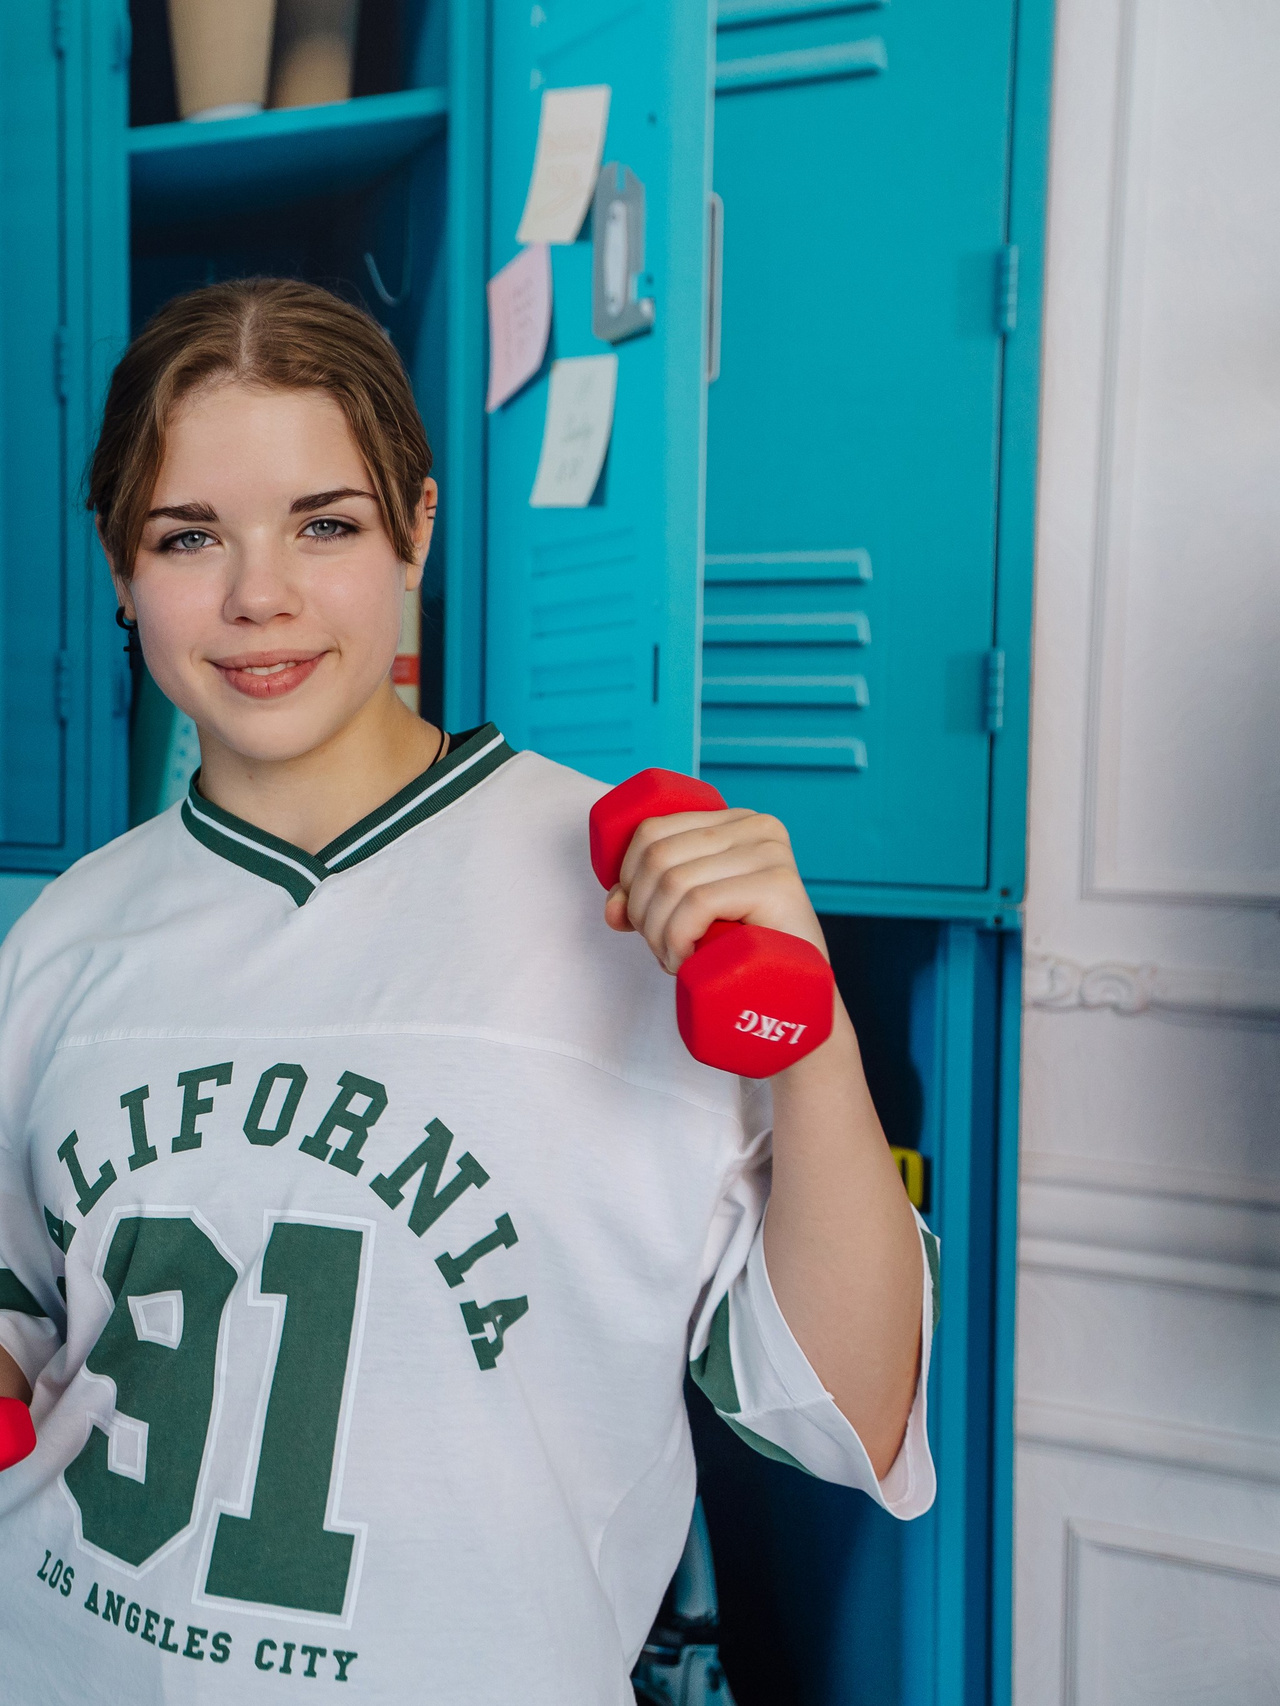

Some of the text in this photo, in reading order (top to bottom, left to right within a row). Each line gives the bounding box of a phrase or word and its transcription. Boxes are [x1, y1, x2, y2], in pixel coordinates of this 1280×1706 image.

[44, 1061, 529, 1371] ALIFORNIA
[57, 1204, 378, 1630] 91
[36, 1549, 358, 1682] LOS ANGELES CITY
